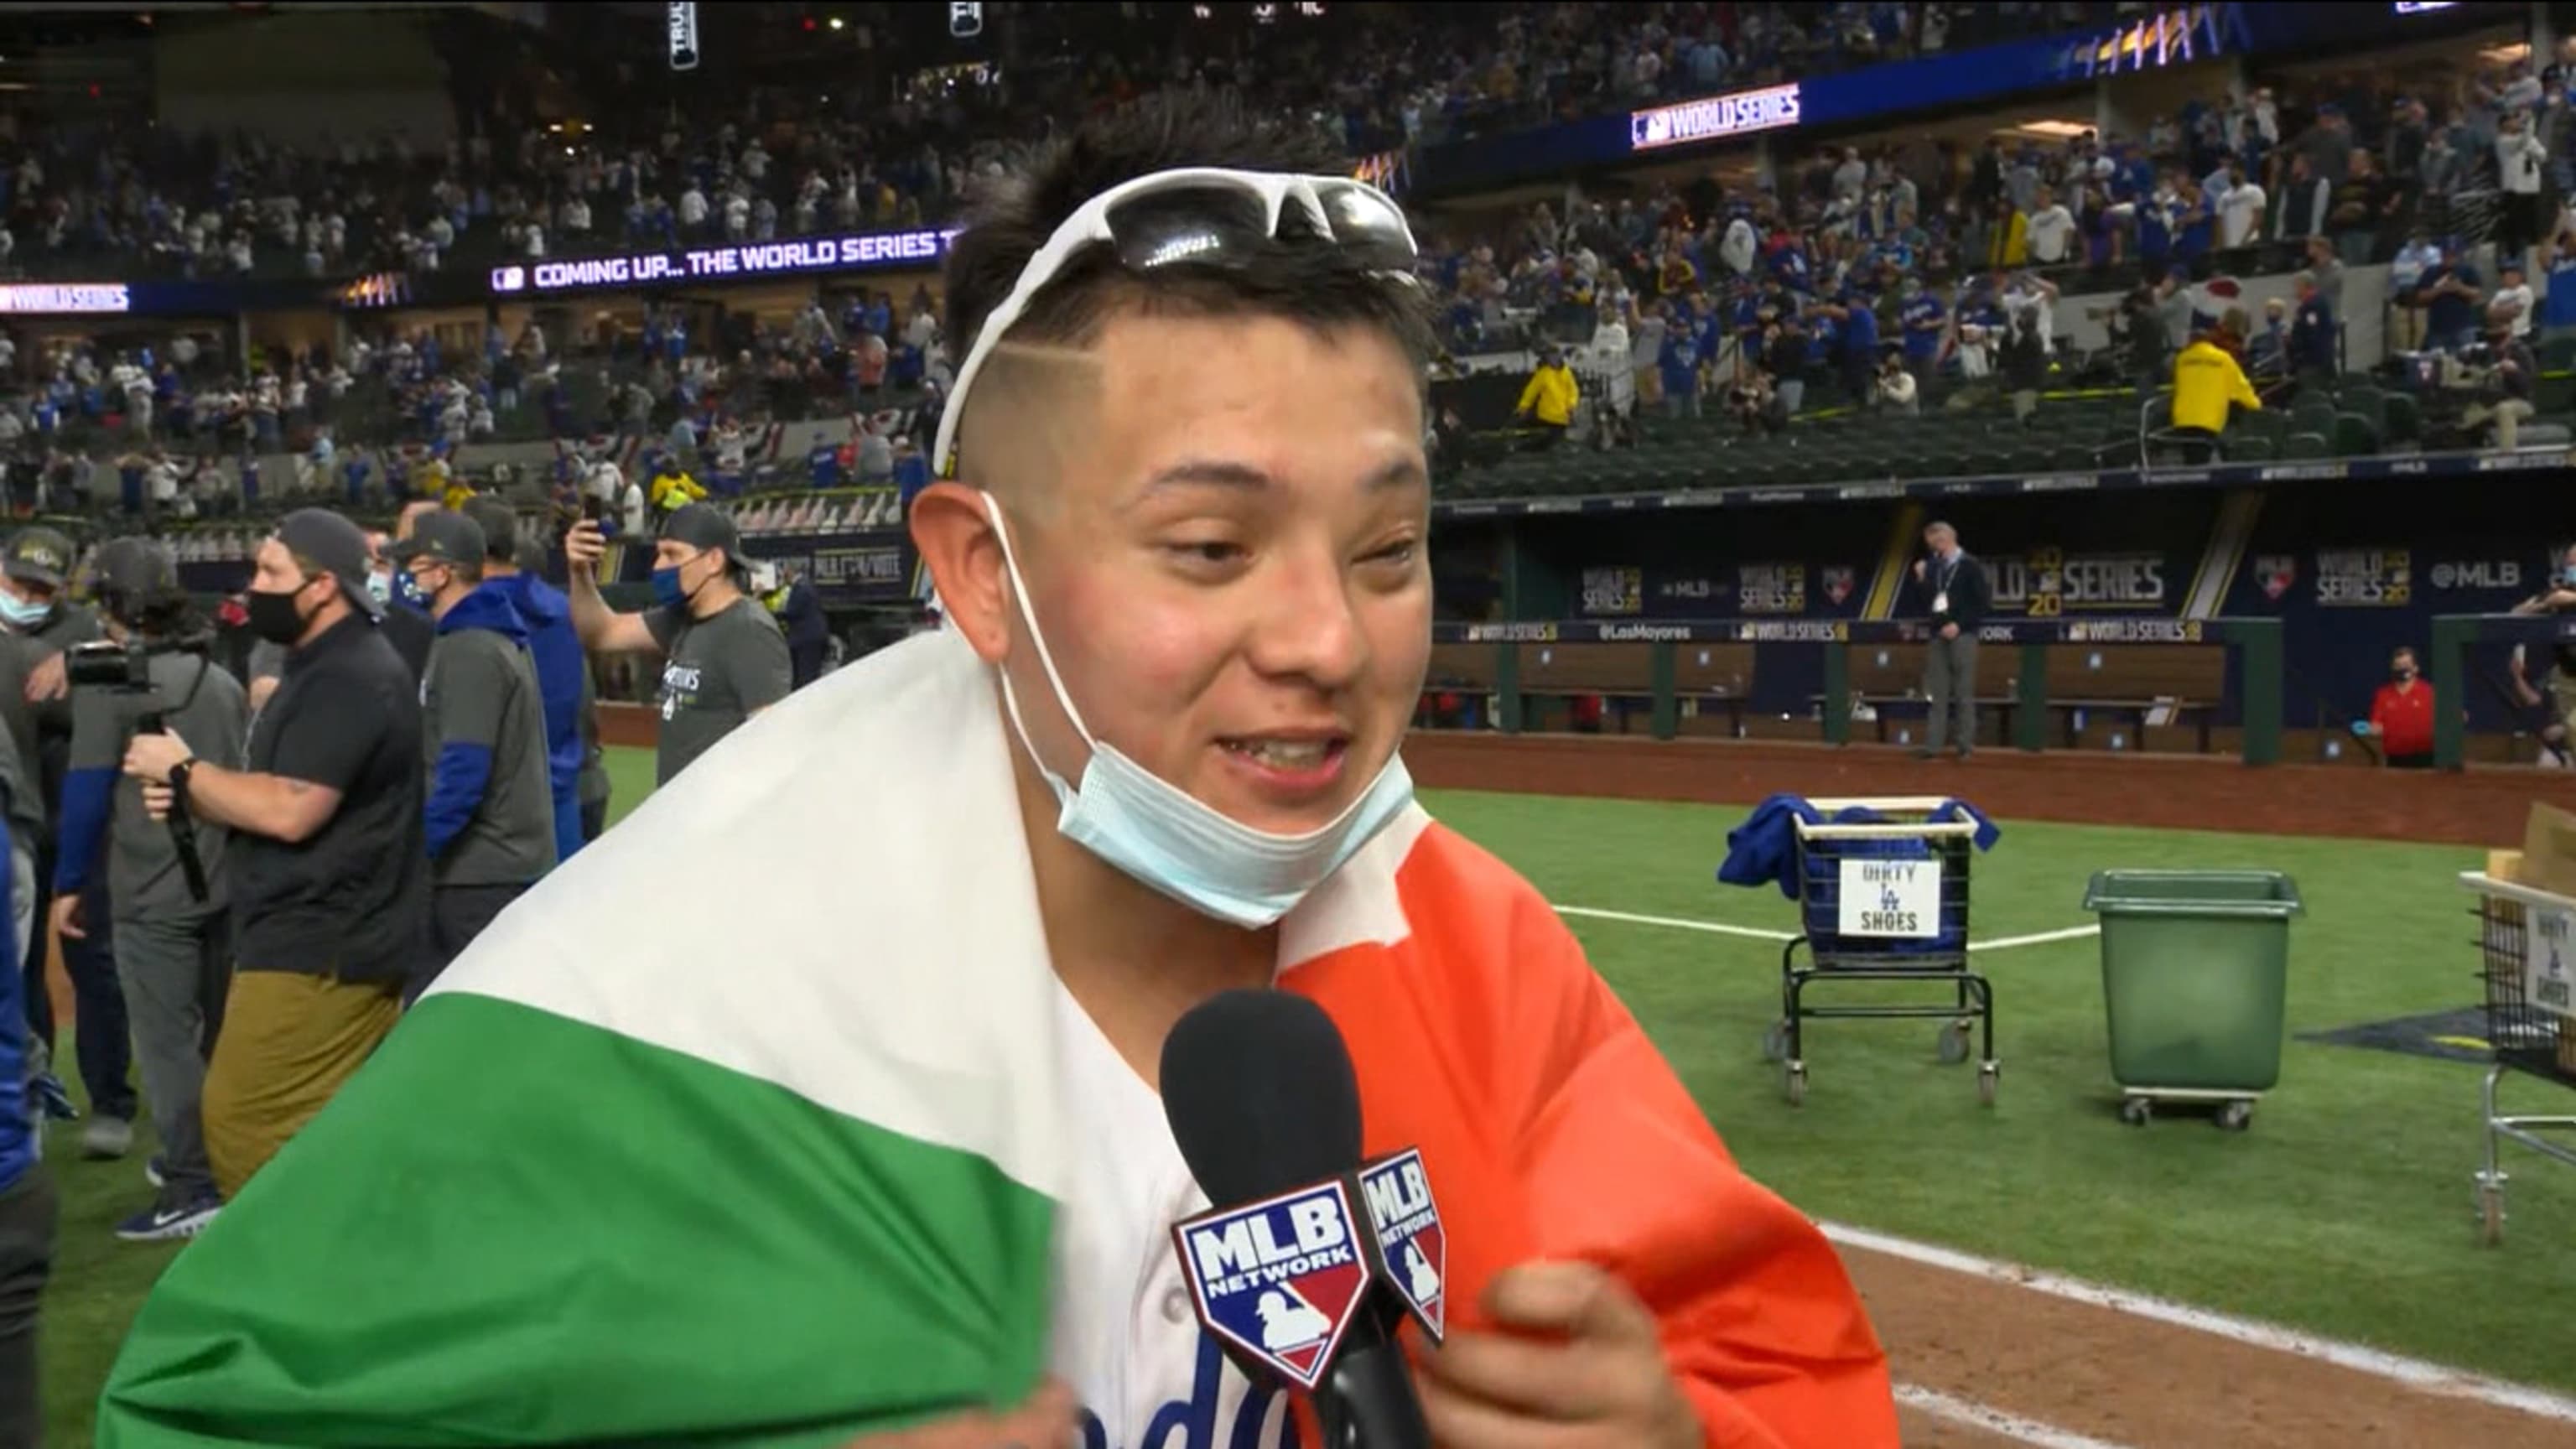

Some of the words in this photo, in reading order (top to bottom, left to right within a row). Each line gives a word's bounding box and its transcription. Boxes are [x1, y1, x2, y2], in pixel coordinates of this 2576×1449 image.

[670, 2, 685, 55] TRUL
[535, 258, 628, 287] COMING
[633, 255, 684, 280] UP...
[687, 247, 738, 275] THE
[742, 240, 836, 270] WORLD
[841, 231, 937, 262] SERIES
[2317, 552, 2384, 575] WORLD
[2430, 561, 2521, 588] @MLB
[2063, 558, 2164, 601] SERIES
[2317, 575, 2384, 602] SERIES
[2027, 593, 2062, 617] 20
[1599, 622, 1691, 641] @LosMayores
[2089, 621, 2137, 641] WORLD
[2137, 620, 2186, 641] SERIES
[1862, 864, 1917, 882] DIRTY
[1860, 911, 1918, 932] SHOES
[1365, 1161, 1430, 1229] MLB
[1192, 1196, 1345, 1281] MLB
[1381, 1208, 1436, 1249] NETWORK
[1207, 1244, 1353, 1299] NETWORK
